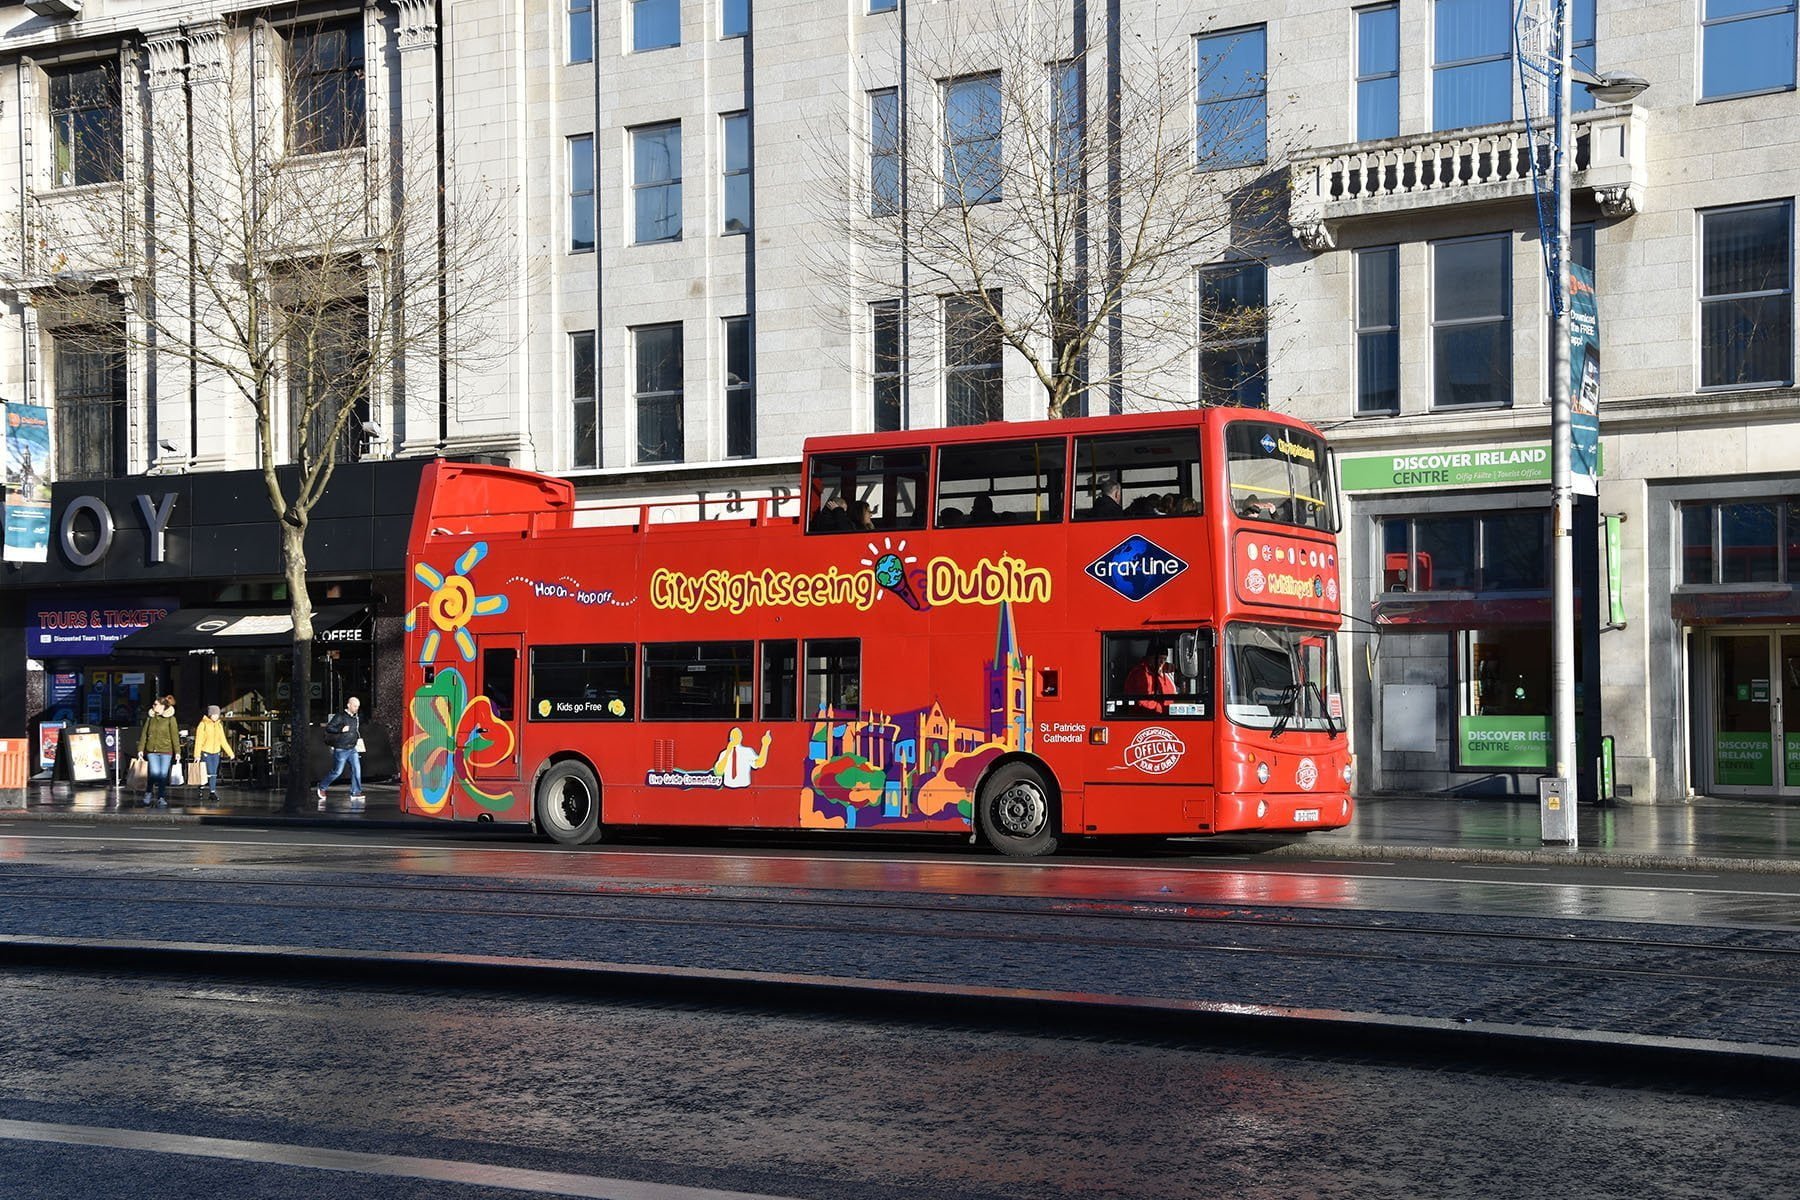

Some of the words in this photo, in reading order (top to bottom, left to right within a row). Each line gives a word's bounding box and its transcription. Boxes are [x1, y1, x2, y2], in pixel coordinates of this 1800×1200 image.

[1580, 323, 1595, 336] FREE
[1393, 453, 1471, 470] DISCOVER
[1475, 449, 1547, 466] IRELAND
[1393, 470, 1449, 485] CENTRE
[1497, 470, 1520, 478] Tourist
[1520, 468, 1542, 478] Office
[60, 492, 179, 567] OY
[927, 556, 1052, 606] Dublin
[556, 586, 567, 597] On
[38, 610, 87, 629] TOURS
[90, 610, 102, 628] &
[104, 608, 167, 628] TICKETS
[557, 702, 573, 711] Kids
[574, 704, 583, 713] go
[585, 702, 602, 711] Free
[1040, 723, 1051, 732] St.
[1053, 722, 1086, 732] Patricks
[1043, 733, 1083, 743] Cathedral
[1467, 731, 1526, 741] DISCOVER
[1134, 742, 1178, 759] OFFICIAL
[1468, 741, 1509, 751] CENTRE
[1718, 741, 1768, 750] DISCOVER
[1718, 751, 1763, 760] IRELAND
